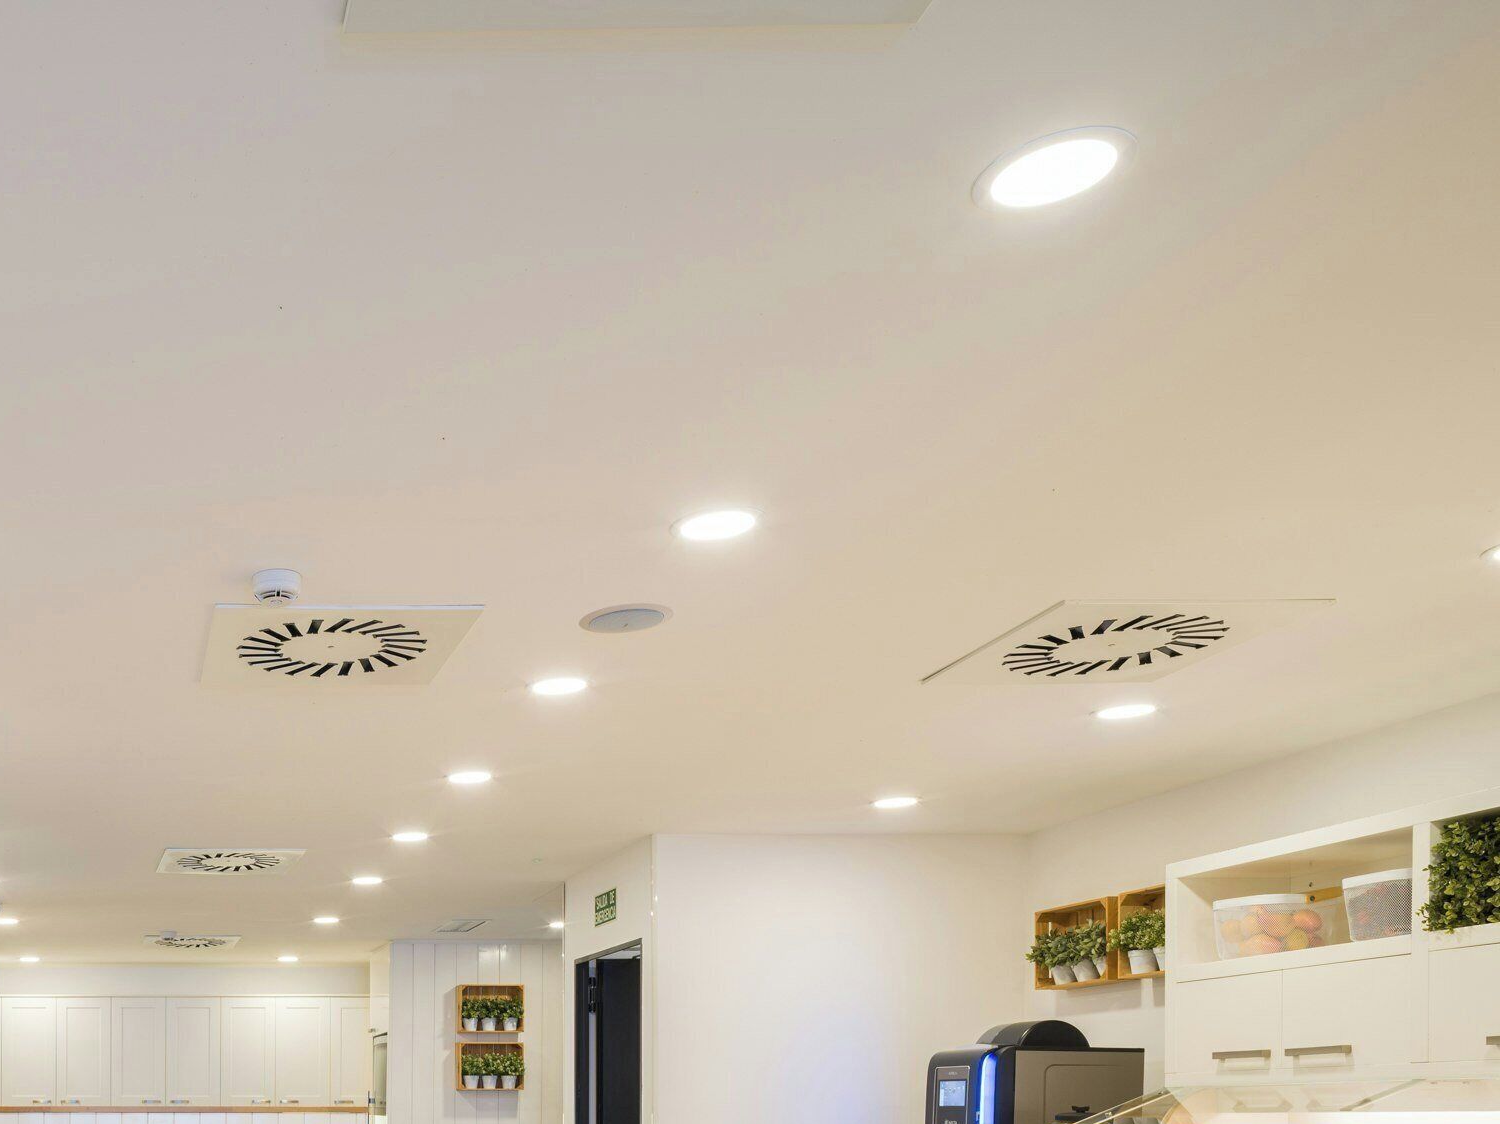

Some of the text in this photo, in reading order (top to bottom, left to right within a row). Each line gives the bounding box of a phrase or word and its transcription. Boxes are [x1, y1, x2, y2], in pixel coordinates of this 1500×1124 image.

[596, 890, 615, 910] SALIDA DE
[595, 905, 616, 924] EMERGENCIA
